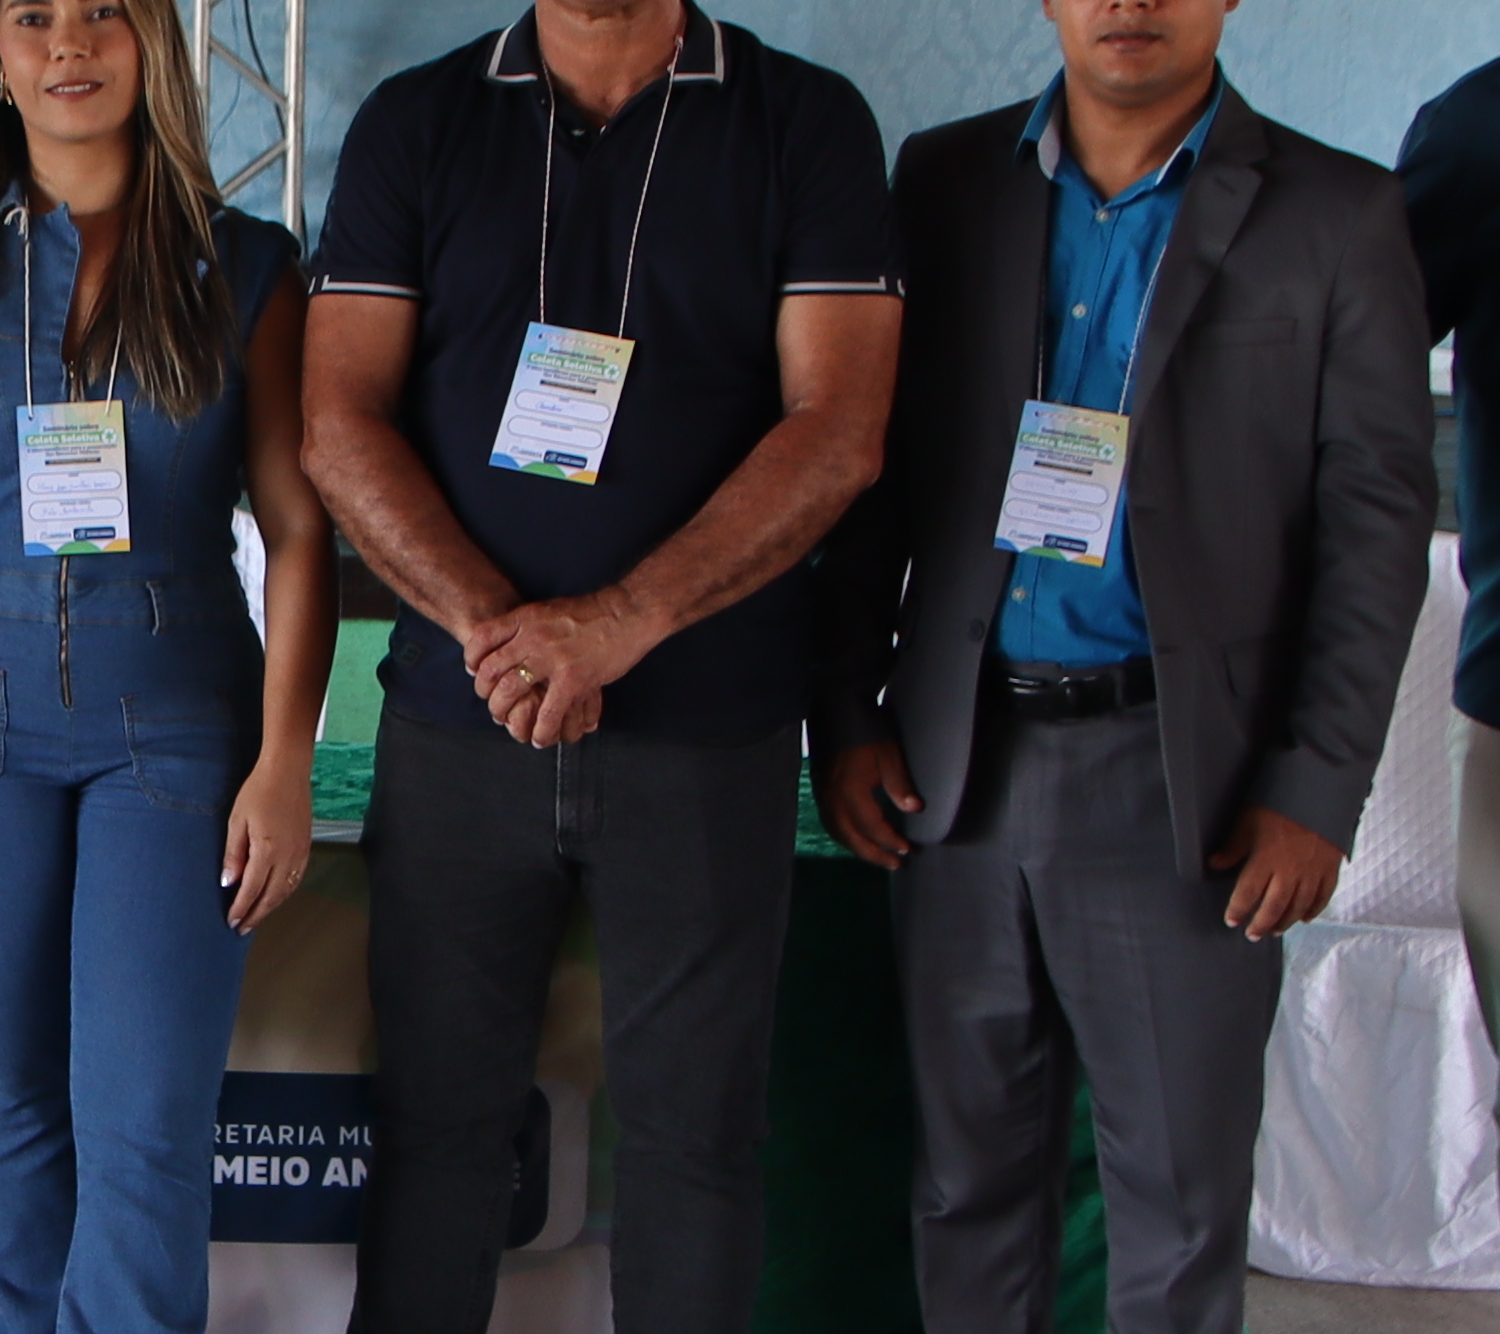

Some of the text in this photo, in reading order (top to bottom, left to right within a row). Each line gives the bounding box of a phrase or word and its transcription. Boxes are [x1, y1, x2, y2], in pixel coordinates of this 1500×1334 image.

[530, 353, 603, 375] Coleta Seletiva
[27, 432, 101, 445] Coleta Seletiva
[213, 1154, 311, 1186] MEIO
